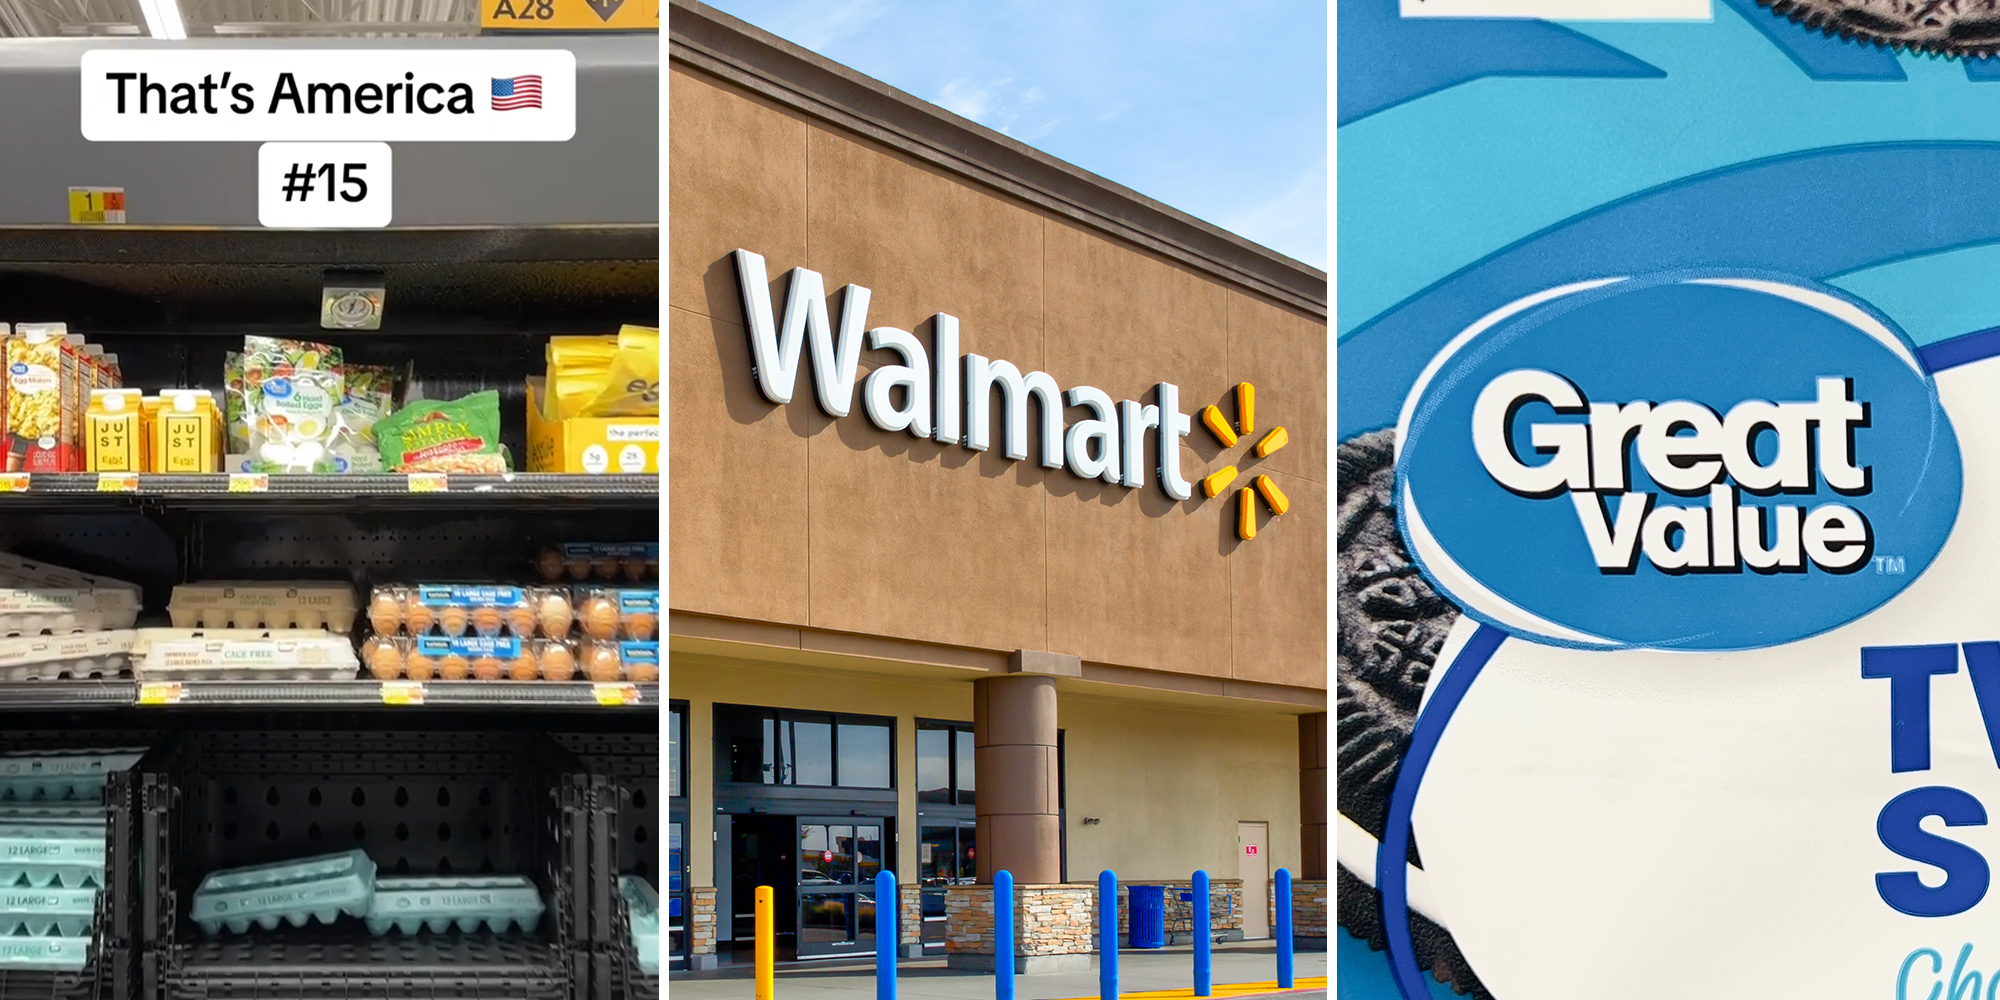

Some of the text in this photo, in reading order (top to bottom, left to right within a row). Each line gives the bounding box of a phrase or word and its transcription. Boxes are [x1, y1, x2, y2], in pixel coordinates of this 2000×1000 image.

[492, 0, 555, 20] A28
[731, 247, 1192, 501] Walmart
[293, 392, 302, 401] 6
[303, 402, 323, 410] Eggs
[609, 429, 625, 438] the
[1472, 368, 1872, 496] Great
[1568, 484, 1906, 575] Value TM
[224, 649, 273, 660] CAGE FREE
[8, 846, 48, 856] 12 LARGE
[6, 896, 46, 906] 12 LARGE
[12, 946, 42, 956] LARGE
